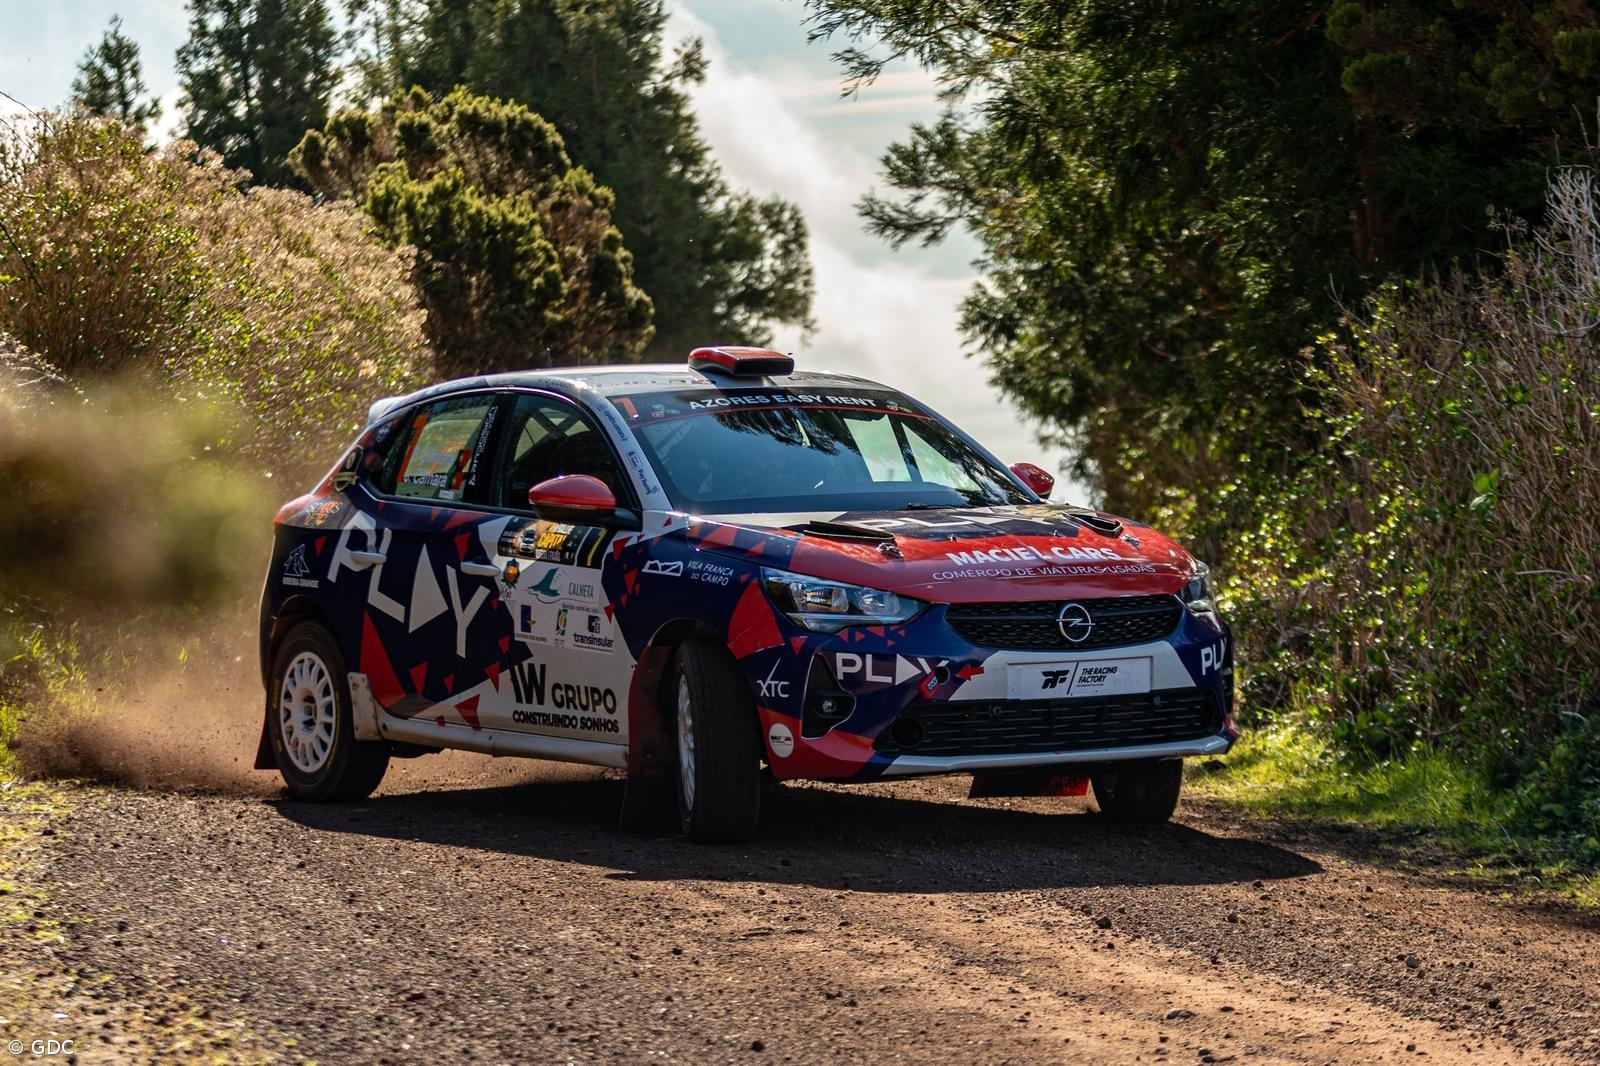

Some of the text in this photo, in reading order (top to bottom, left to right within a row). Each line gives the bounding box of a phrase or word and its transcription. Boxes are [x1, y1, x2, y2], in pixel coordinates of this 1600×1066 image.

[689, 394, 877, 411] AZORES EASY RENT
[946, 546, 1122, 566] MACIEL CARS
[687, 560, 704, 570] VILA
[1015, 568, 1034, 577] DE
[1038, 566, 1106, 576] VIATURAS
[1108, 565, 1157, 574] USADAS
[327, 509, 491, 659] PLAY
[700, 573, 730, 586] CAMPO
[568, 582, 594, 598] CALHETA
[573, 632, 614, 649] transinsular
[756, 657, 791, 698] XTC
[835, 652, 950, 686] PLAY
[1081, 665, 1118, 676] THE RACING
[1077, 675, 1108, 684] FACTORY
[551, 682, 617, 715] GRUPO
[512, 710, 620, 733] CONSTRUINDO SONHOS
